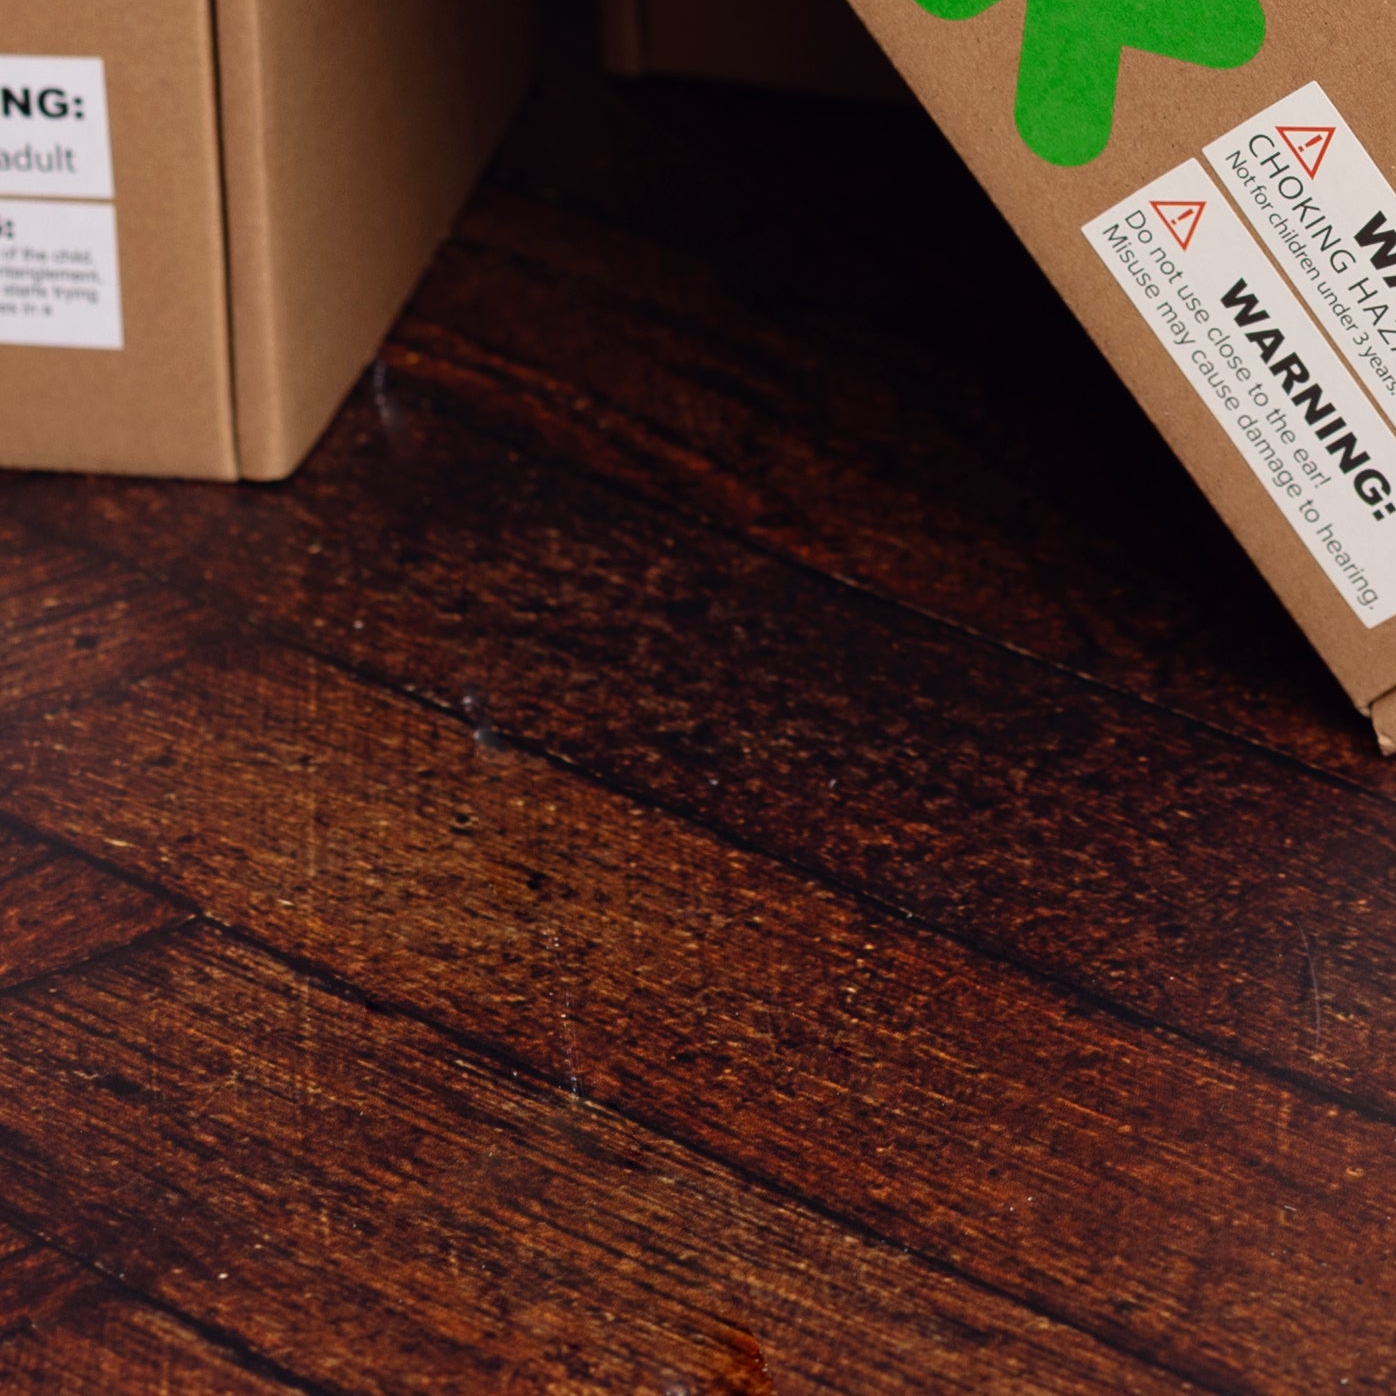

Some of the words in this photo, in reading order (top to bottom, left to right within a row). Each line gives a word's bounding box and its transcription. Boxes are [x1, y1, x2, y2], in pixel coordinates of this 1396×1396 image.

[1224, 149, 1256, 187] Not
[1249, 184, 1274, 210] for
[1267, 212, 1320, 281] children
[1316, 280, 1359, 331] under
[1351, 331, 1369, 345] 3
[1247, 133, 1357, 274] CHOKING
[1101, 222, 1160, 299] Misuse
[1155, 300, 1196, 345] may
[1190, 349, 1240, 411] cause
[1236, 413, 1302, 498] damage
[1298, 498, 1320, 523] to
[1315, 522, 1378, 610] hearing.
[1123, 208, 1153, 244] Do
[1148, 246, 1183, 284] not
[1176, 284, 1210, 324] use
[1206, 326, 1251, 382] close
[1247, 382, 1269, 407] to
[1265, 407, 1296, 444] the
[1292, 447, 1332, 488] ear!
[1220, 277, 1396, 520] WARNING:
